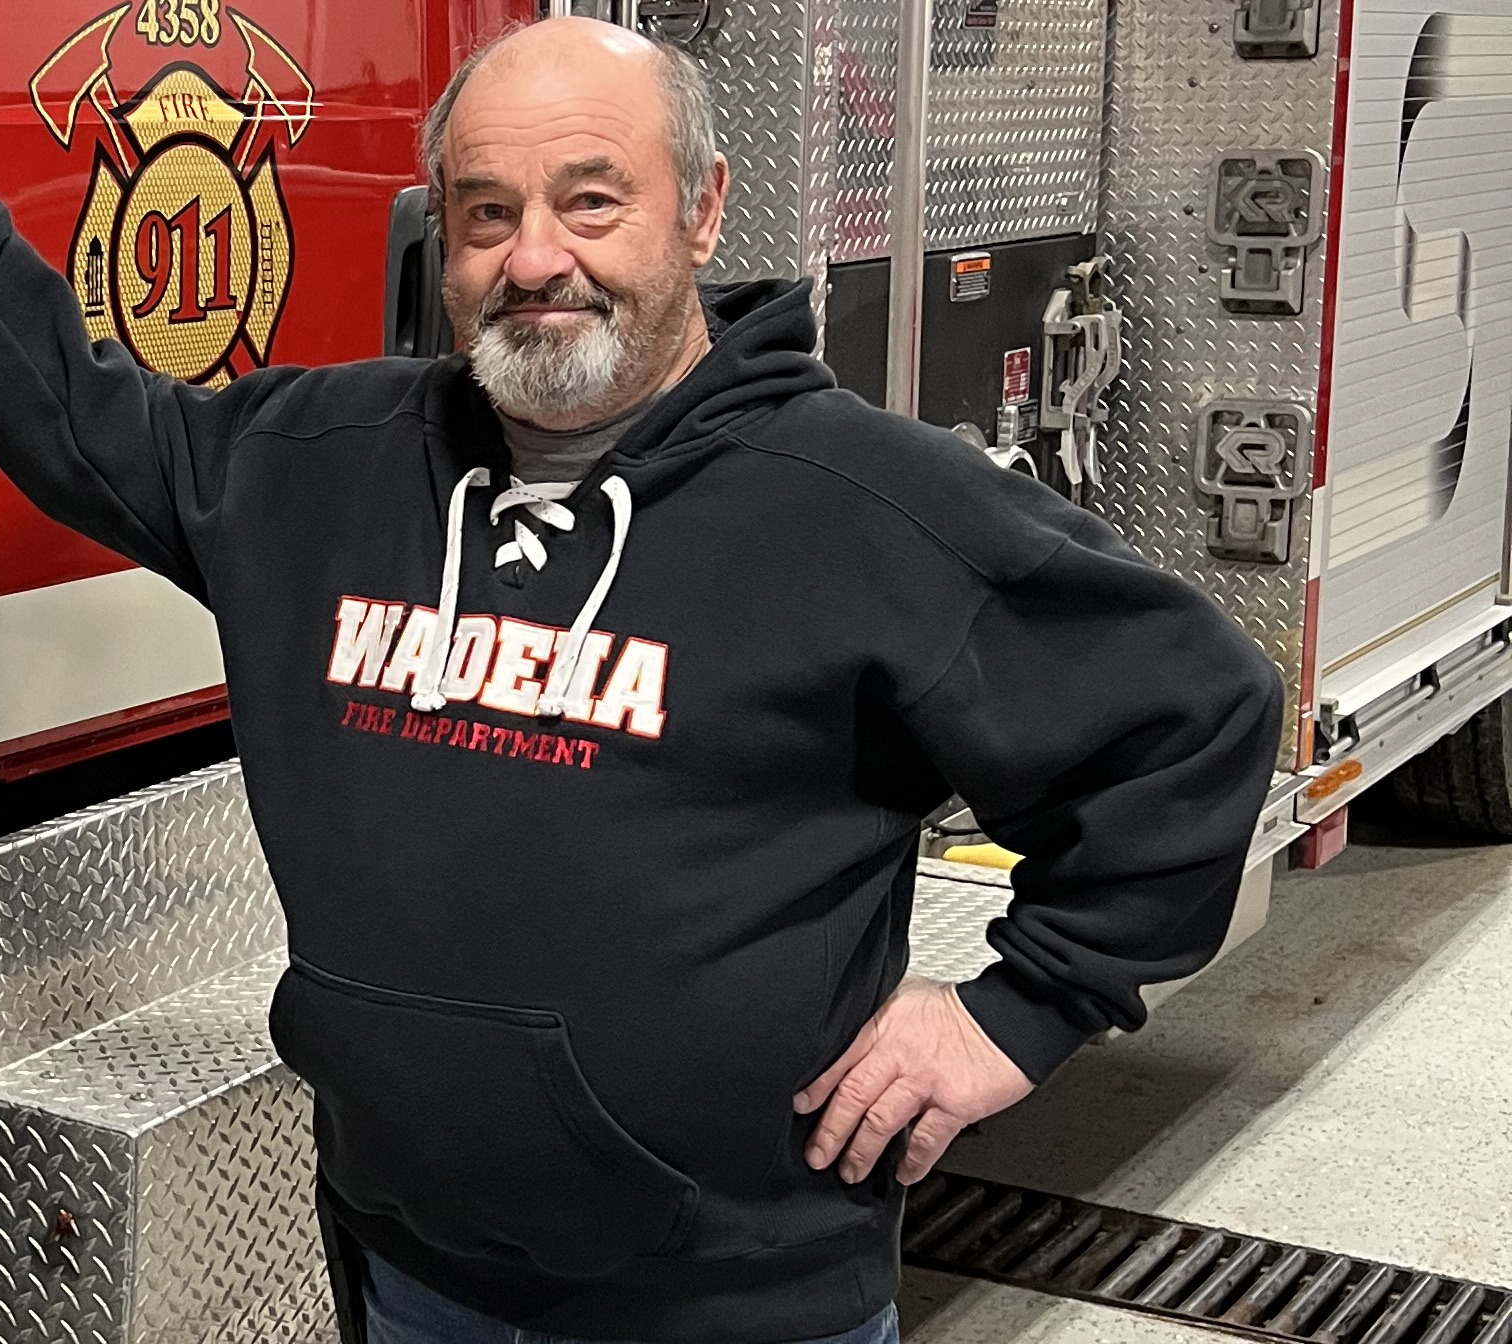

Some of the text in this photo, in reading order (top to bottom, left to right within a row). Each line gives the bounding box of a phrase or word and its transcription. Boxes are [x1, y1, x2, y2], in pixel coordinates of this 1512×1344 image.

[158, 92, 215, 125] FIRE
[131, 194, 239, 325] 911
[340, 700, 601, 770] FIRE DEPARTMENT
